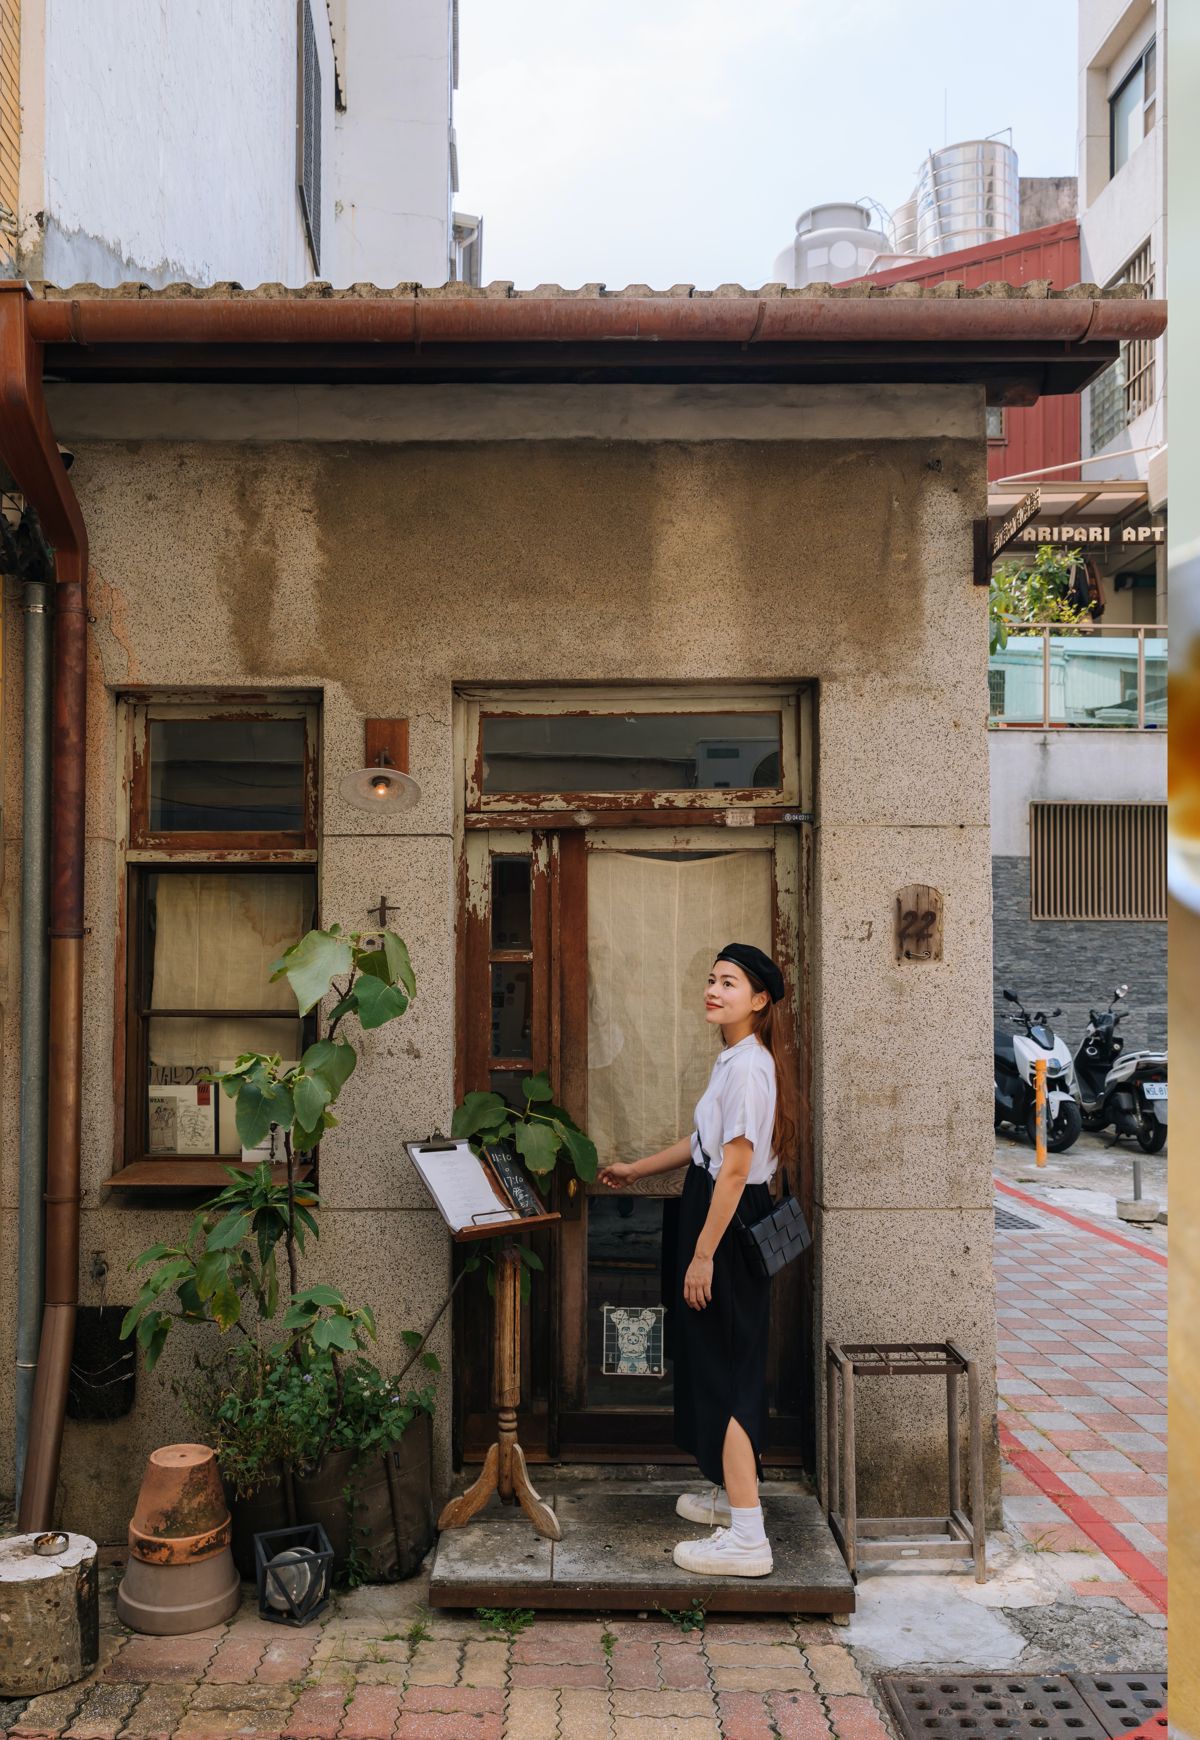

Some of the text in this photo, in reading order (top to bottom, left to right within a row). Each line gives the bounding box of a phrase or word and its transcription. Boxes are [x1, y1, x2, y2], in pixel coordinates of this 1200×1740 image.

[1016, 527, 1164, 541] ARIPARI APT
[899, 910, 937, 939] 22
